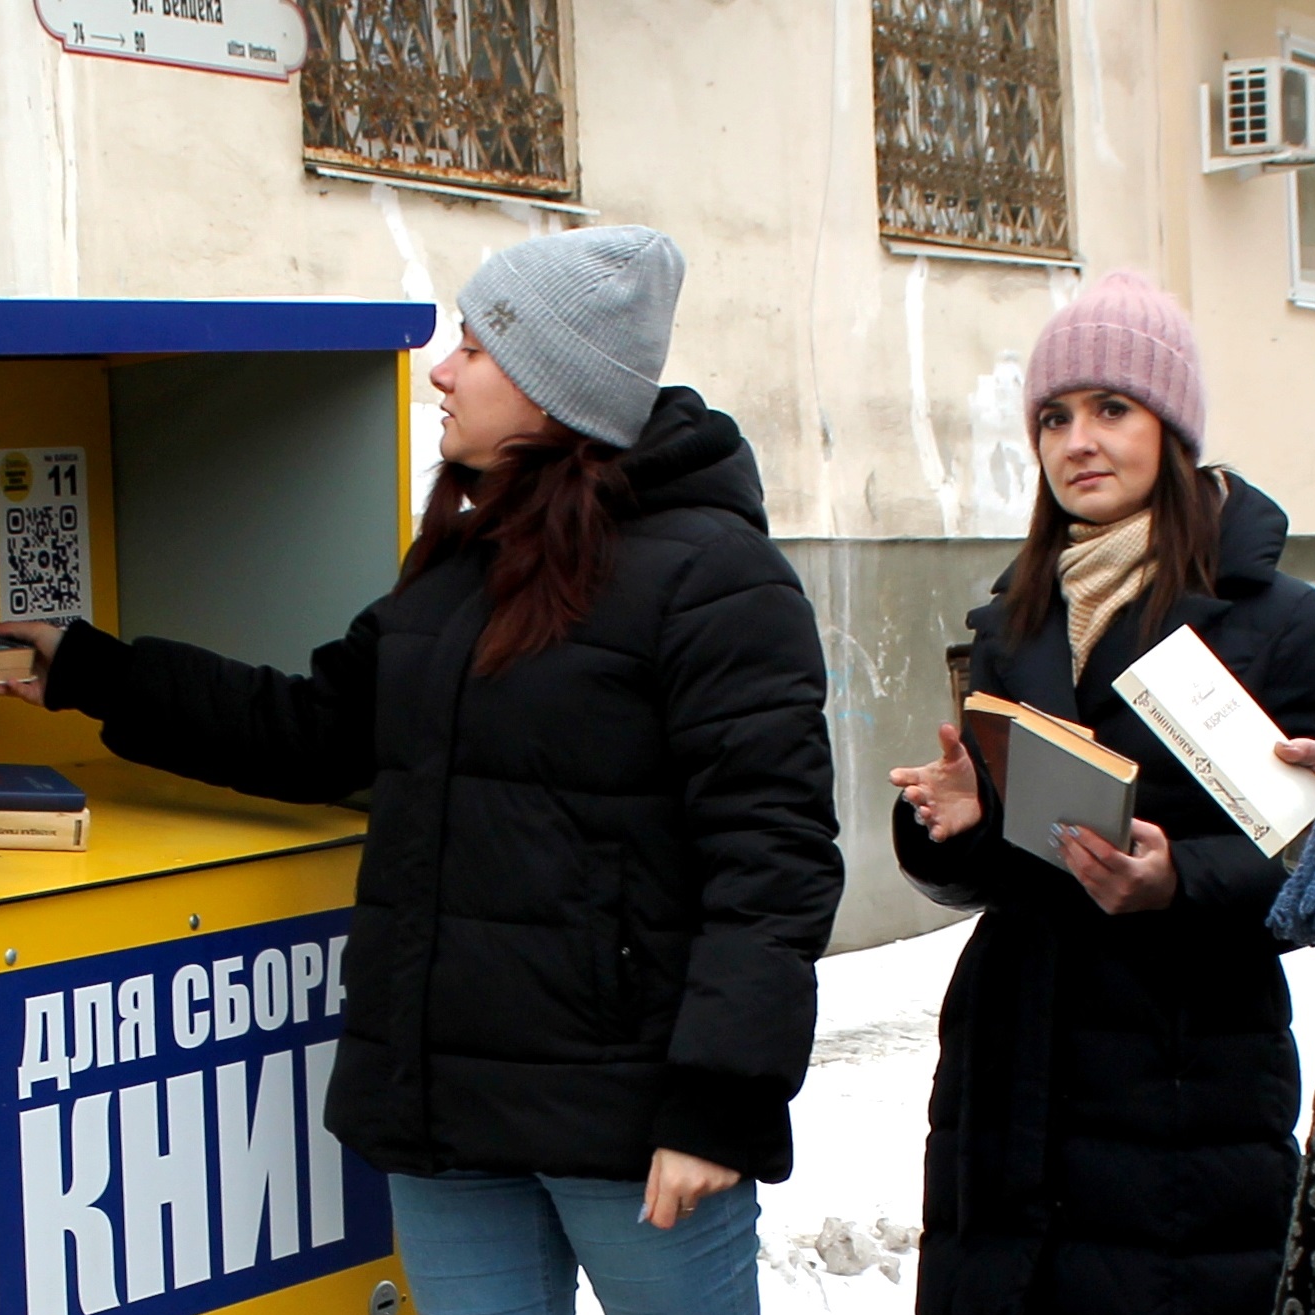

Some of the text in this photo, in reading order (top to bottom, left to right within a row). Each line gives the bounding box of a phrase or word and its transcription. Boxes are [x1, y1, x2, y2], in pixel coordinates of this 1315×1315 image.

[73, 22, 146, 53] 74 90
[47, 464, 77, 496] 11
[17, 973, 158, 1100] ДЛЯ
